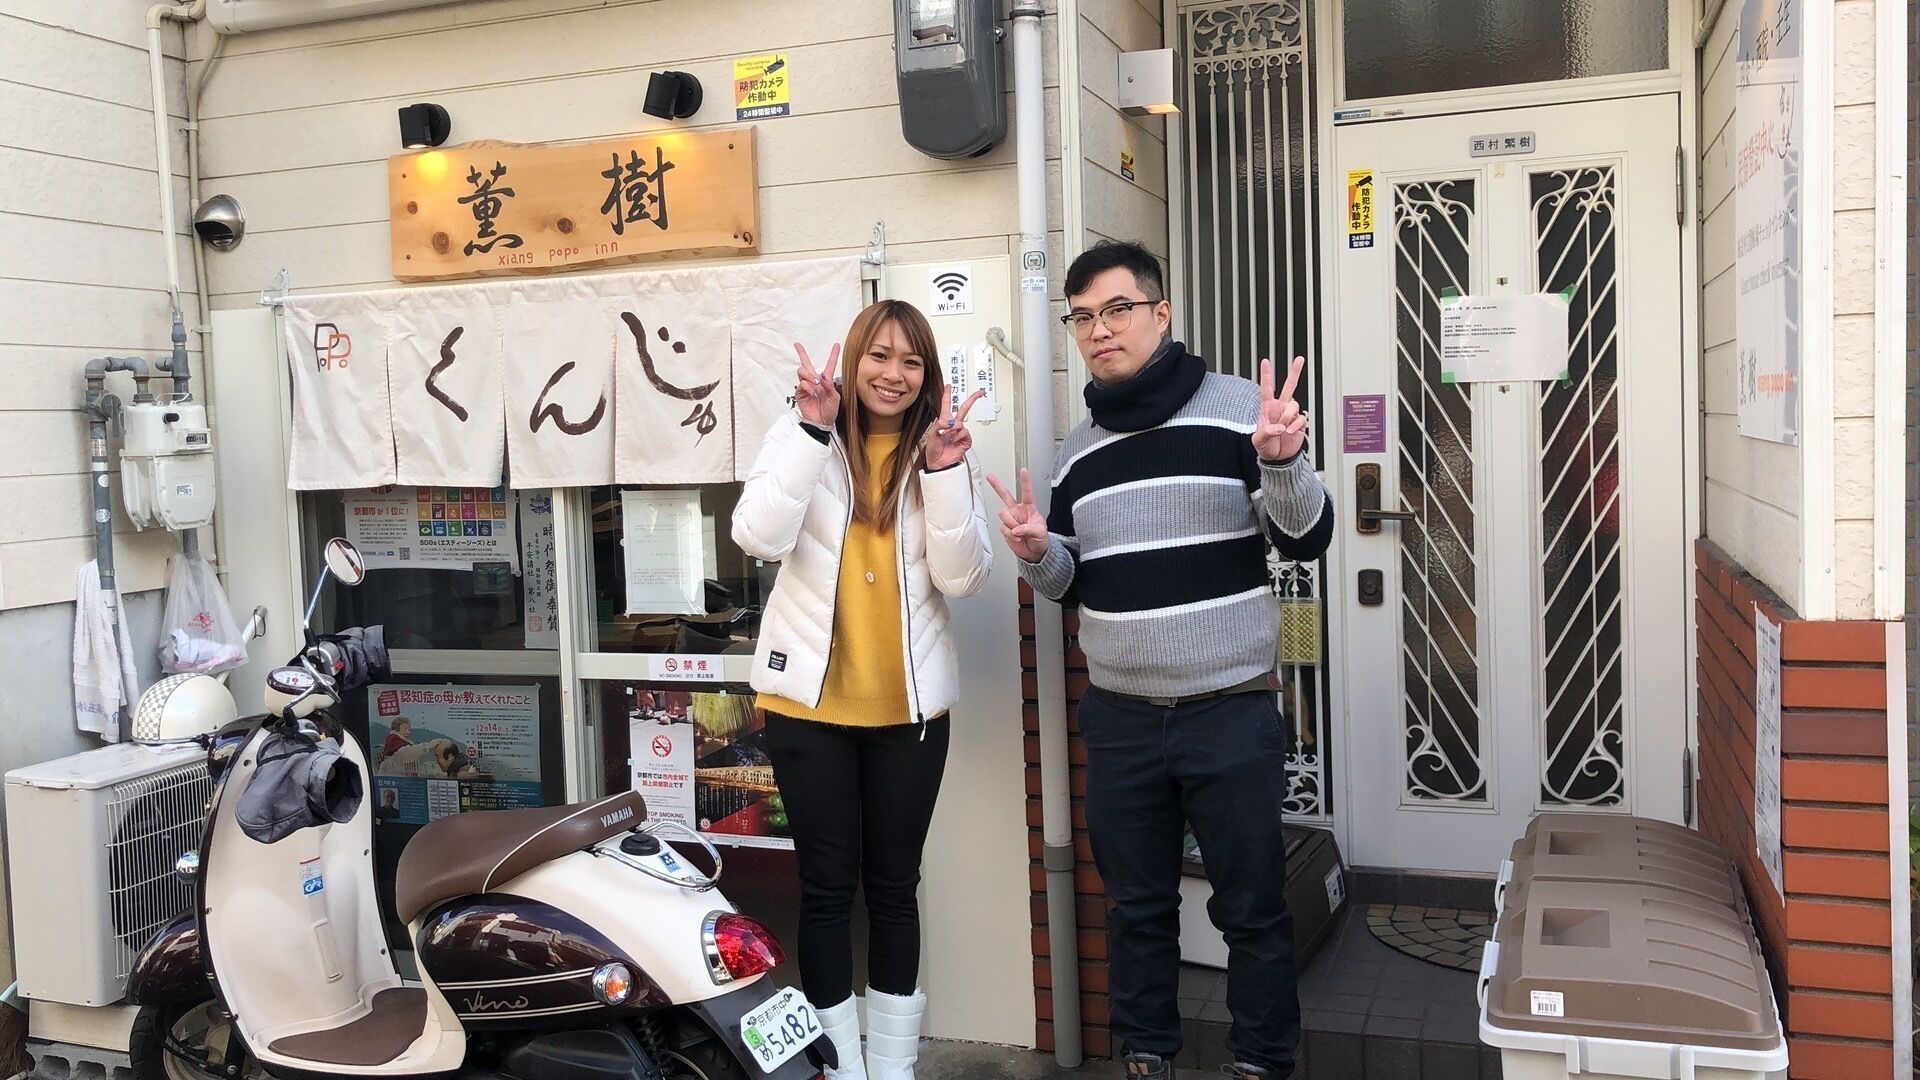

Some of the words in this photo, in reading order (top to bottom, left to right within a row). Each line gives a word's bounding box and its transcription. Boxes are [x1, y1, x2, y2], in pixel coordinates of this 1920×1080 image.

[739, 76, 784, 92] 防犯カメラ
[747, 89, 777, 103] 作動中
[742, 105, 784, 118] 24時間監視中
[1473, 136, 1531, 151] 西村繁樹
[1351, 202, 1361, 230] 作動中
[1361, 187, 1371, 230] 防犯カメラ
[498, 251, 534, 266] xiang
[549, 246, 579, 261] popo
[594, 241, 619, 255] inn
[938, 302, 966, 311] Wi-Fi
[951, 356, 959, 413] 市政協力委員
[683, 660, 708, 671] 禁煙
[400, 689, 531, 705] 認知症の母が教えてくれたこと
[601, 806, 633, 828] YAMAHA
[659, 811, 684, 819] SMOKING
[464, 991, 529, 1012] Vino
[757, 998, 788, 1027] 京都市中
[766, 1004, 818, 1055] 5482
[750, 1034, 760, 1045] 3
[759, 1043, 774, 1062] め
